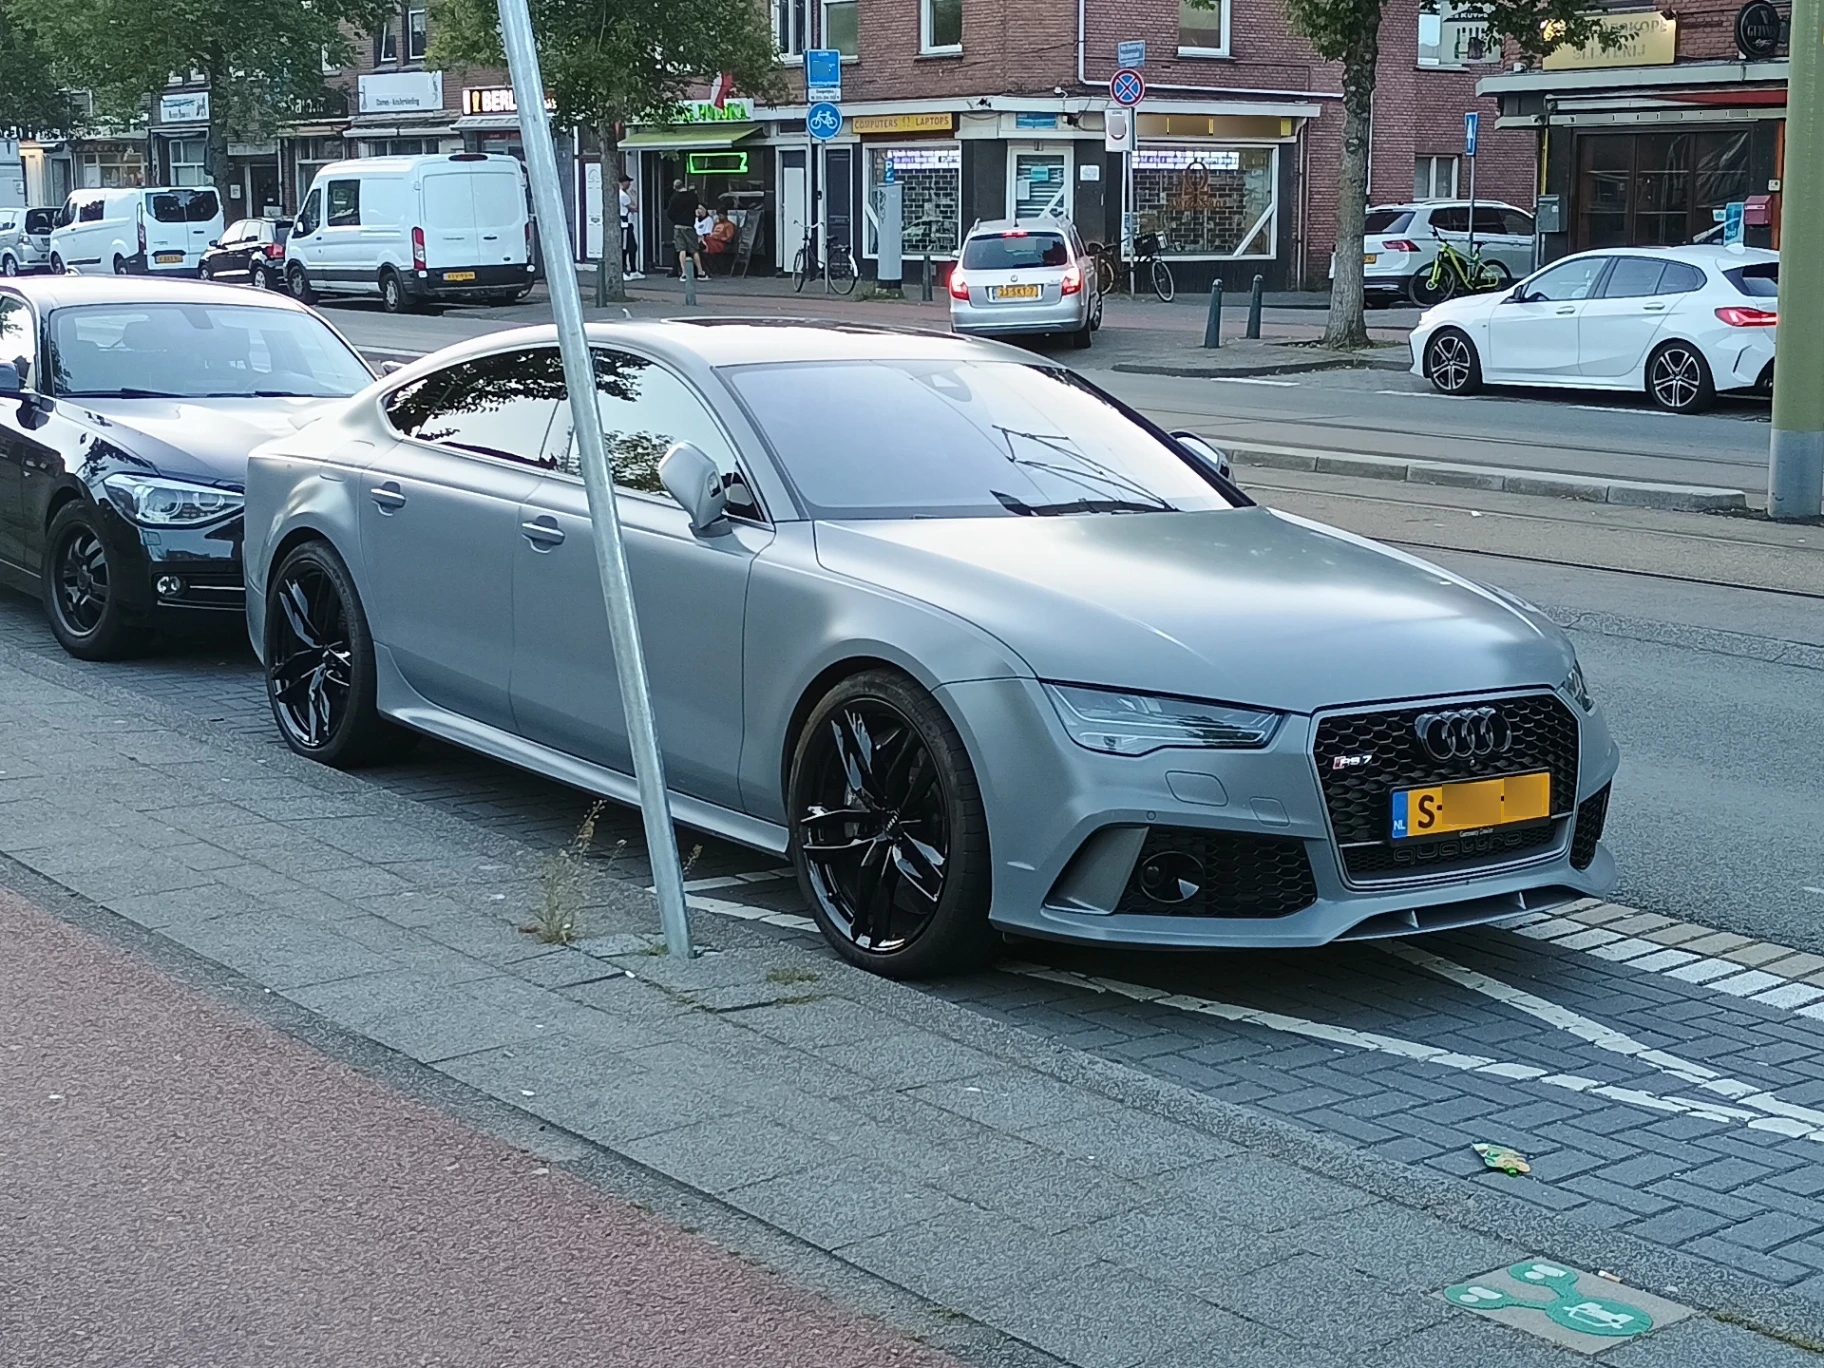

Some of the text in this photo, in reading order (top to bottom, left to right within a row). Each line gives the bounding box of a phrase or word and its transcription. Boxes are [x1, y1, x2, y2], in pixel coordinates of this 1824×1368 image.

[854, 119, 898, 129] COMPUTERS
[915, 116, 949, 126] LAPTOPS
[1393, 820, 1406, 830] NL
[1393, 831, 1522, 865] quattro
